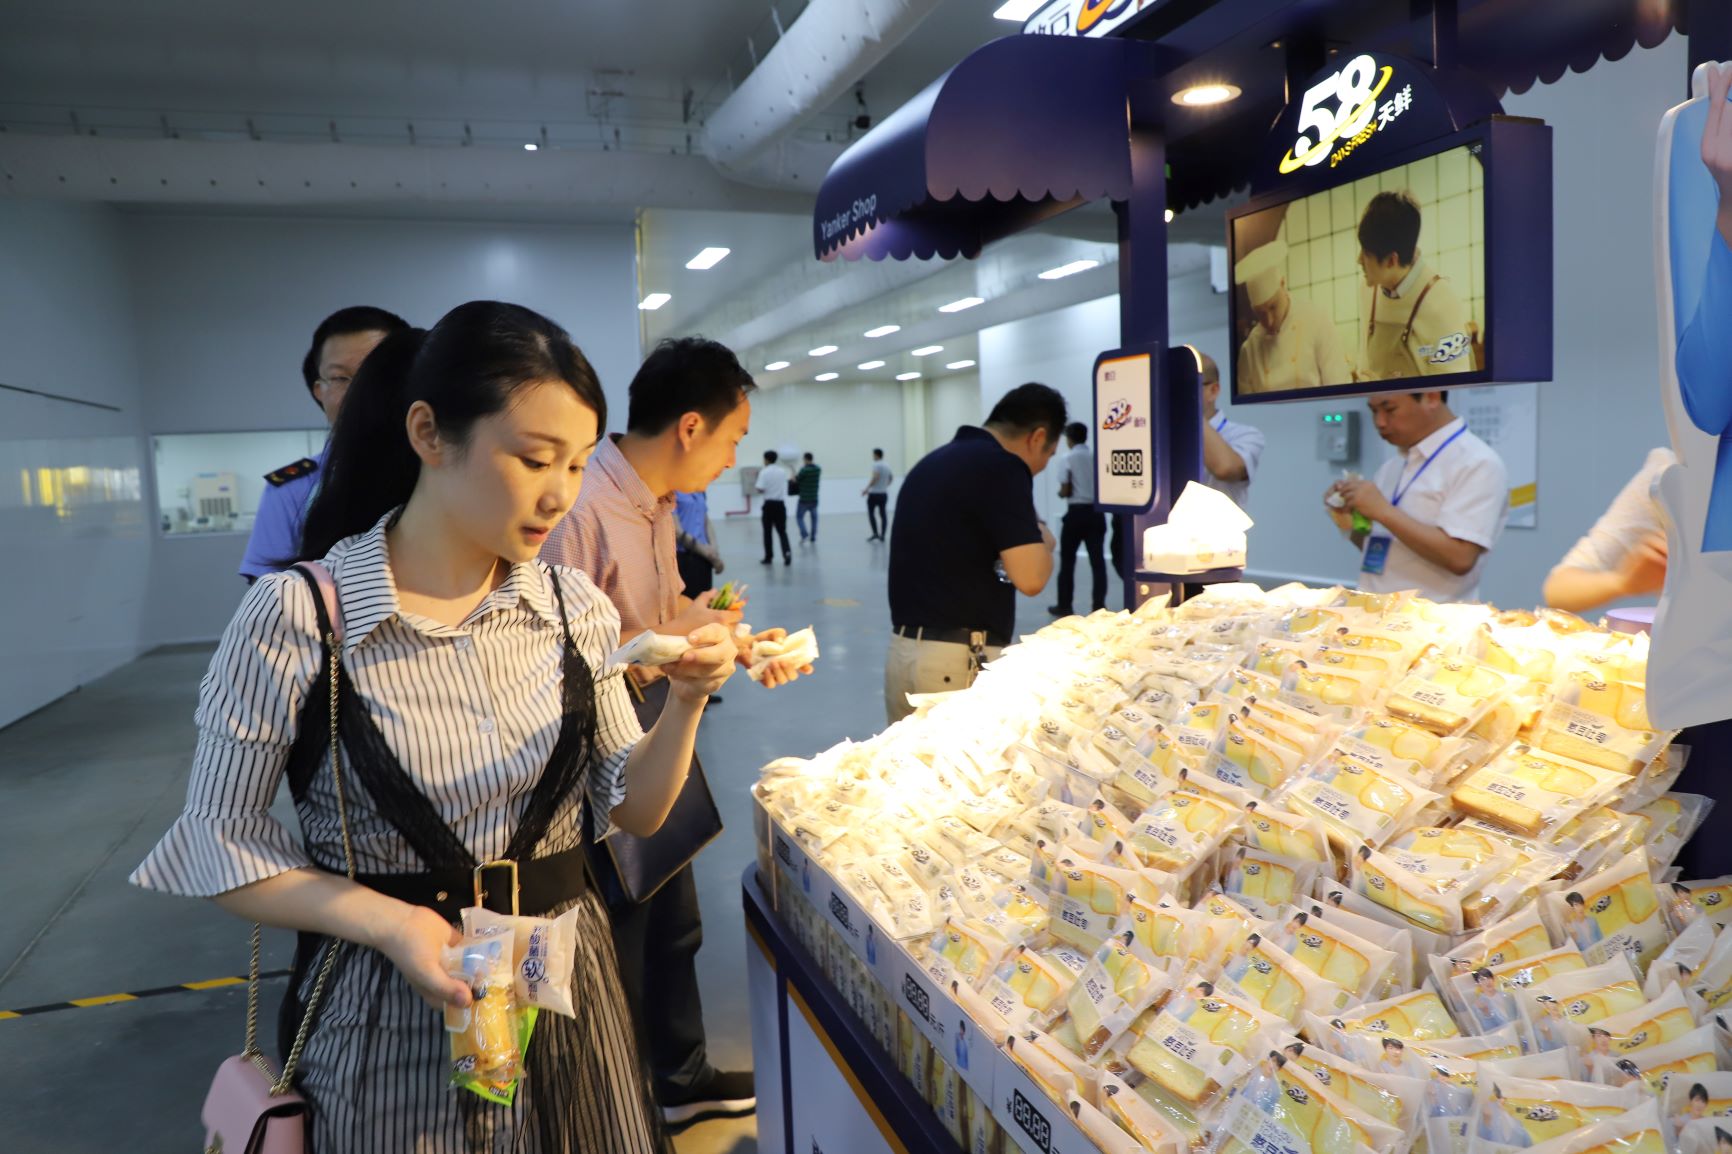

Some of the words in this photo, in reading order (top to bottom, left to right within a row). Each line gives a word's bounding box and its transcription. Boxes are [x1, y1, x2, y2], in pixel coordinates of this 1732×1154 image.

[1295, 54, 1376, 166] 58
[1377, 83, 1412, 131] 天鲜
[821, 210, 851, 240] Yanker
[851, 193, 877, 222] Shop
